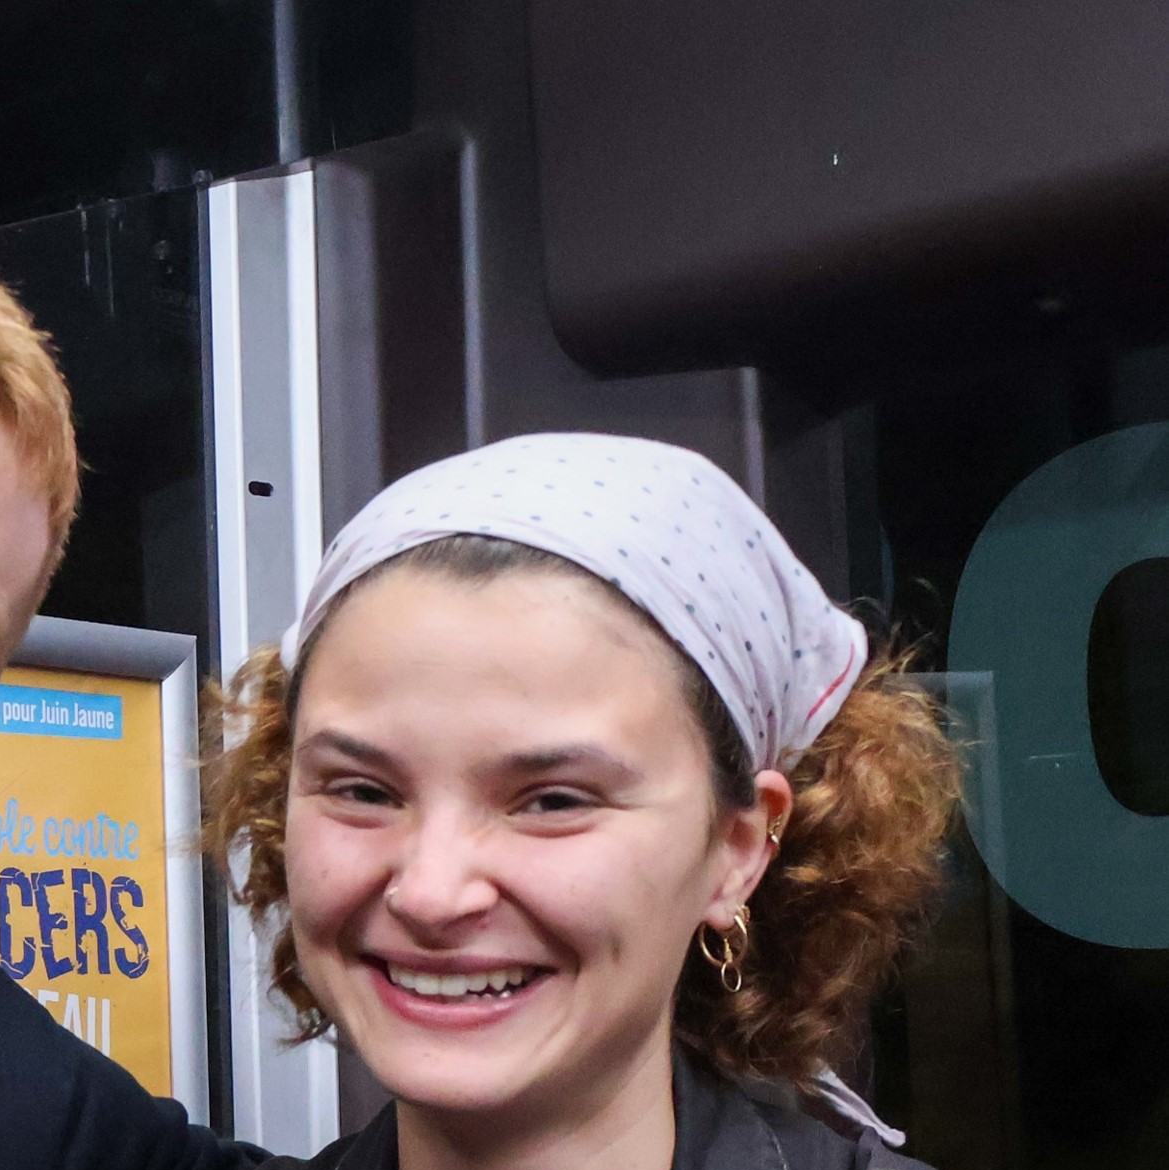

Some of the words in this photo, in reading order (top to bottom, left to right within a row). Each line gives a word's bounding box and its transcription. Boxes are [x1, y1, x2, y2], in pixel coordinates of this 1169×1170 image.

[2, 701, 37, 725] pour
[40, 699, 69, 726] Juin
[72, 702, 114, 730] Jaune
[43, 811, 141, 860] contre
